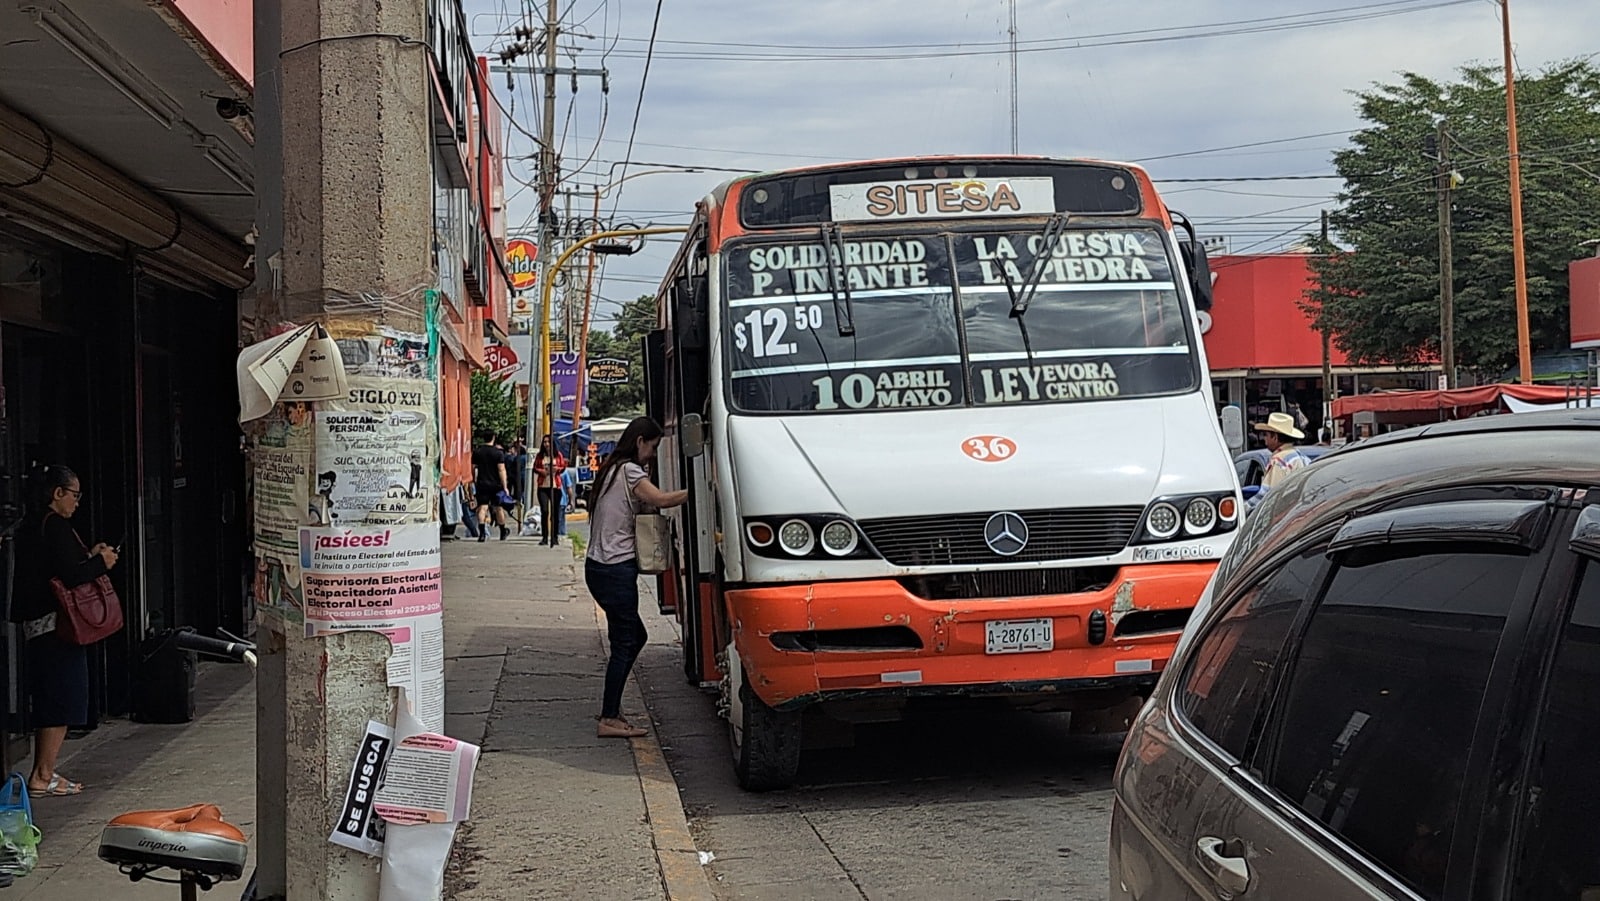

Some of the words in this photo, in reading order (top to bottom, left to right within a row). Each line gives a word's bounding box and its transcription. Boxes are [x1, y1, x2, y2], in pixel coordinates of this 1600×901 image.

[866, 180, 1022, 217] SITESA
[750, 240, 926, 272] SOLIDARIDAD
[973, 236, 1018, 261] LA
[1027, 232, 1146, 258] CUESTA
[752, 271, 784, 296] P.
[793, 262, 930, 294] INFANTE
[979, 257, 1024, 284] LA
[1033, 256, 1153, 282] PIEDRA
[551, 368, 578, 376] PTICA
[812, 372, 876, 411] 10
[876, 369, 951, 390] ABRIL
[981, 365, 1042, 403] LEY
[1043, 361, 1116, 382] EVORA
[1046, 379, 1120, 400] CENTRO
[349, 389, 397, 404] SIGLO
[400, 391, 422, 406] XXI
[876, 388, 953, 409] MAYO
[329, 424, 377, 433] PERSONAL
[967, 436, 1011, 459] 36
[389, 502, 407, 512] AÑO
[321, 553, 357, 561] Instituto
[358, 552, 394, 560] Electoral
[407, 549, 428, 557] Estado
[321, 561, 343, 570] invita
[352, 561, 392, 571] participar
[306, 576, 380, 588] Supervisor/a
[382, 572, 427, 584] Electoral
[313, 586, 397, 600] Capacitador/a
[307, 598, 356, 609] Electoral
[358, 598, 393, 608] Local
[322, 609, 363, 617] Proceso
[363, 607, 404, 617] Electoral
[988, 627, 1051, 645] A-28761-U
[354, 739, 384, 804] BUSCA
[346, 807, 363, 833] SE
[137, 837, 189, 853] imperio
